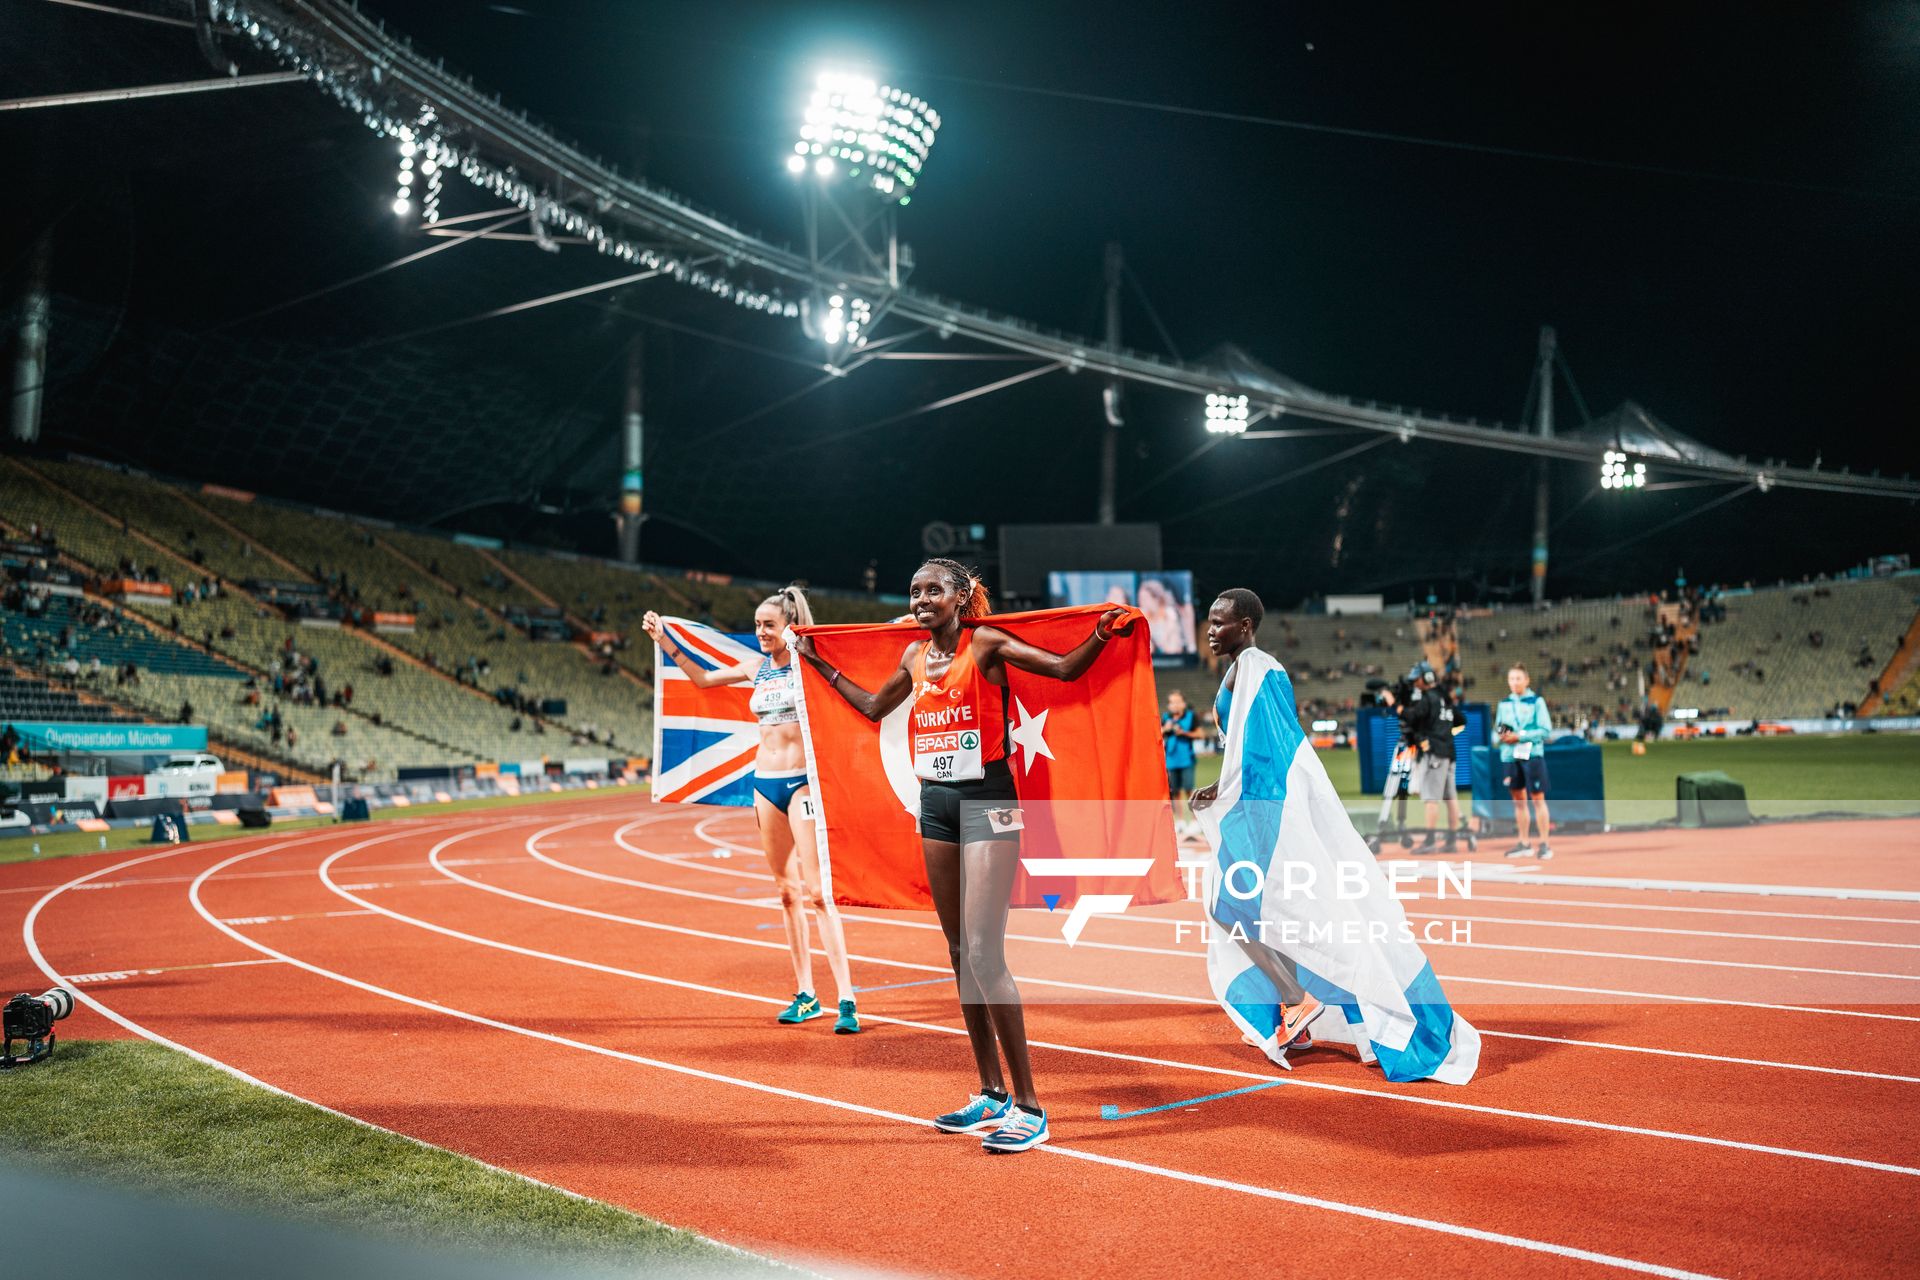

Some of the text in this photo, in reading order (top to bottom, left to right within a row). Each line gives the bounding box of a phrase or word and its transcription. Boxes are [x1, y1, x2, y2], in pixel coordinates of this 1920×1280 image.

[915, 705, 973, 728] TÜRKİYE
[46, 727, 173, 747] Olympiastadion München
[917, 735, 958, 752] SPAR
[932, 755, 954, 771] 497
[936, 770, 953, 779] CAN
